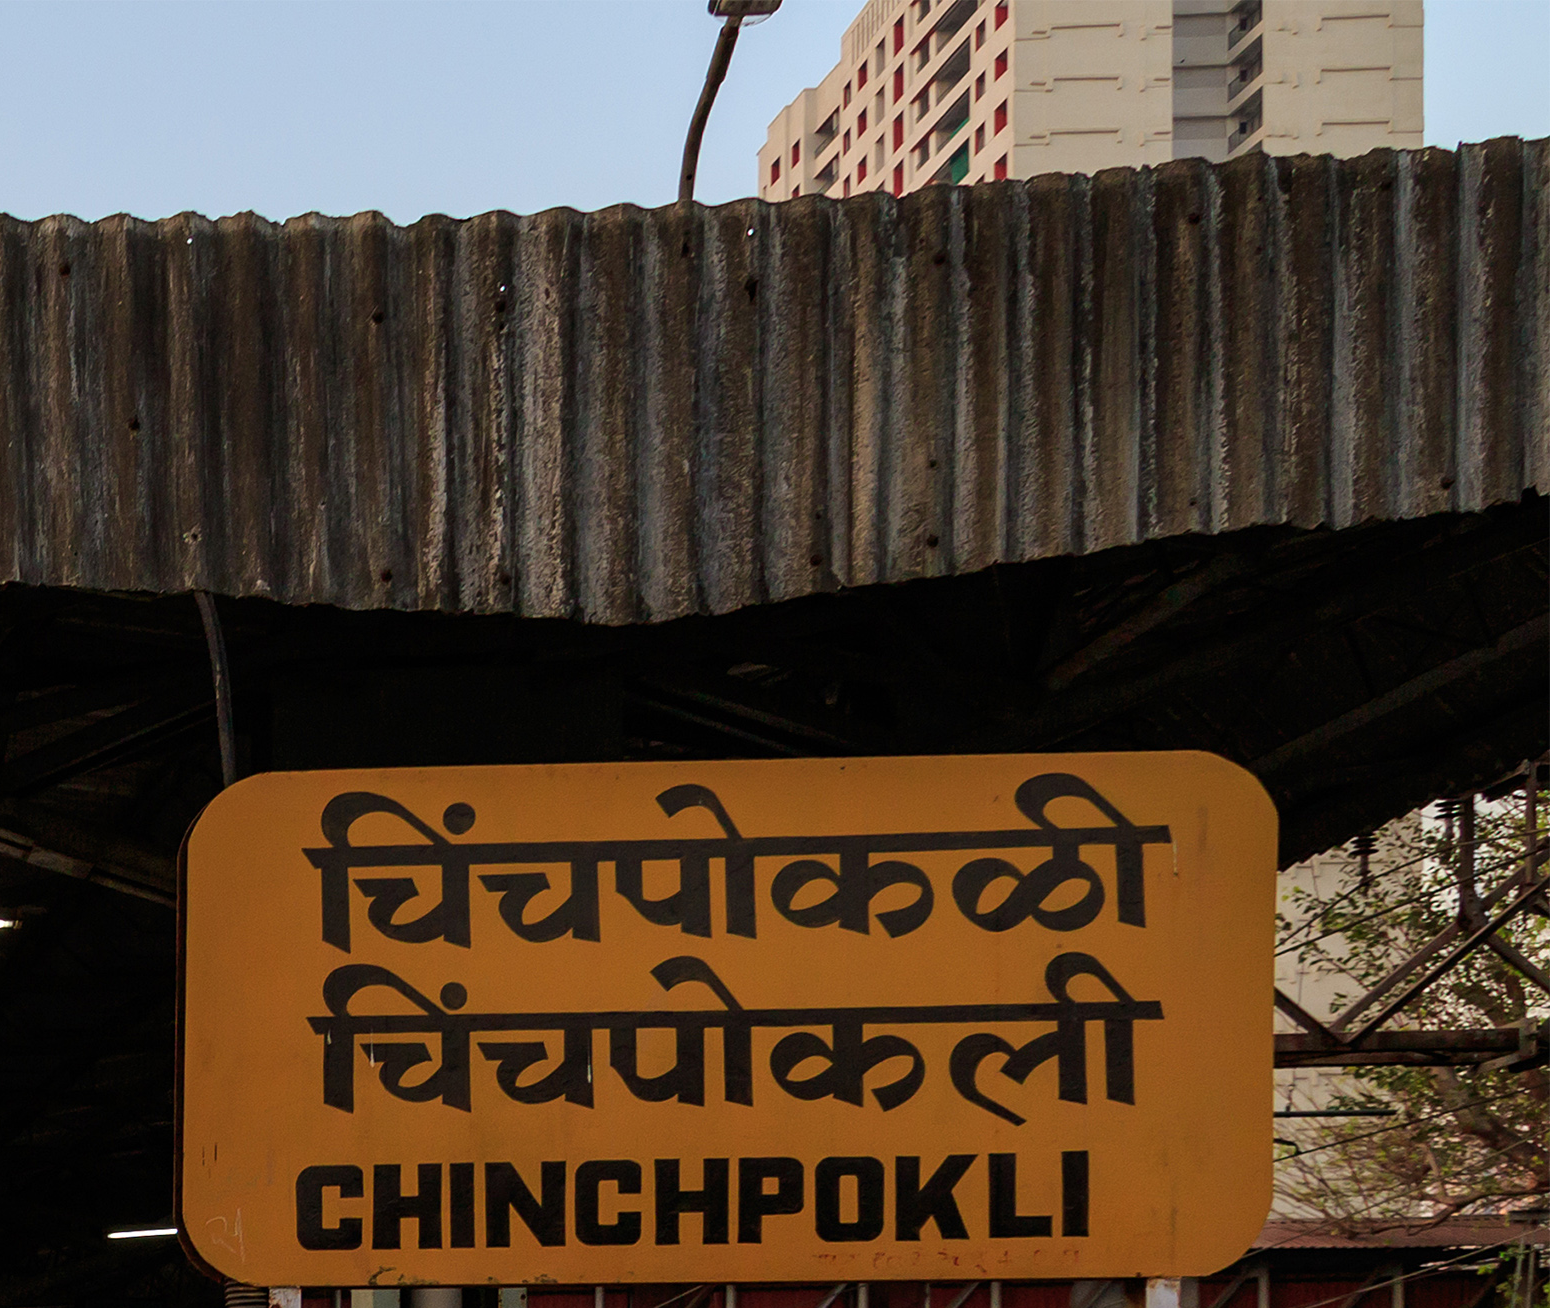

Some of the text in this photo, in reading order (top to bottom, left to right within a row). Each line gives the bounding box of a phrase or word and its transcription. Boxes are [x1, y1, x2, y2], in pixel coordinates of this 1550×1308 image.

[301, 772, 1172, 954] चिंचपोकळी
[306, 951, 1165, 1127] चिंचपोकली
[296, 1150, 1090, 1251] CHINCHPOKLI
